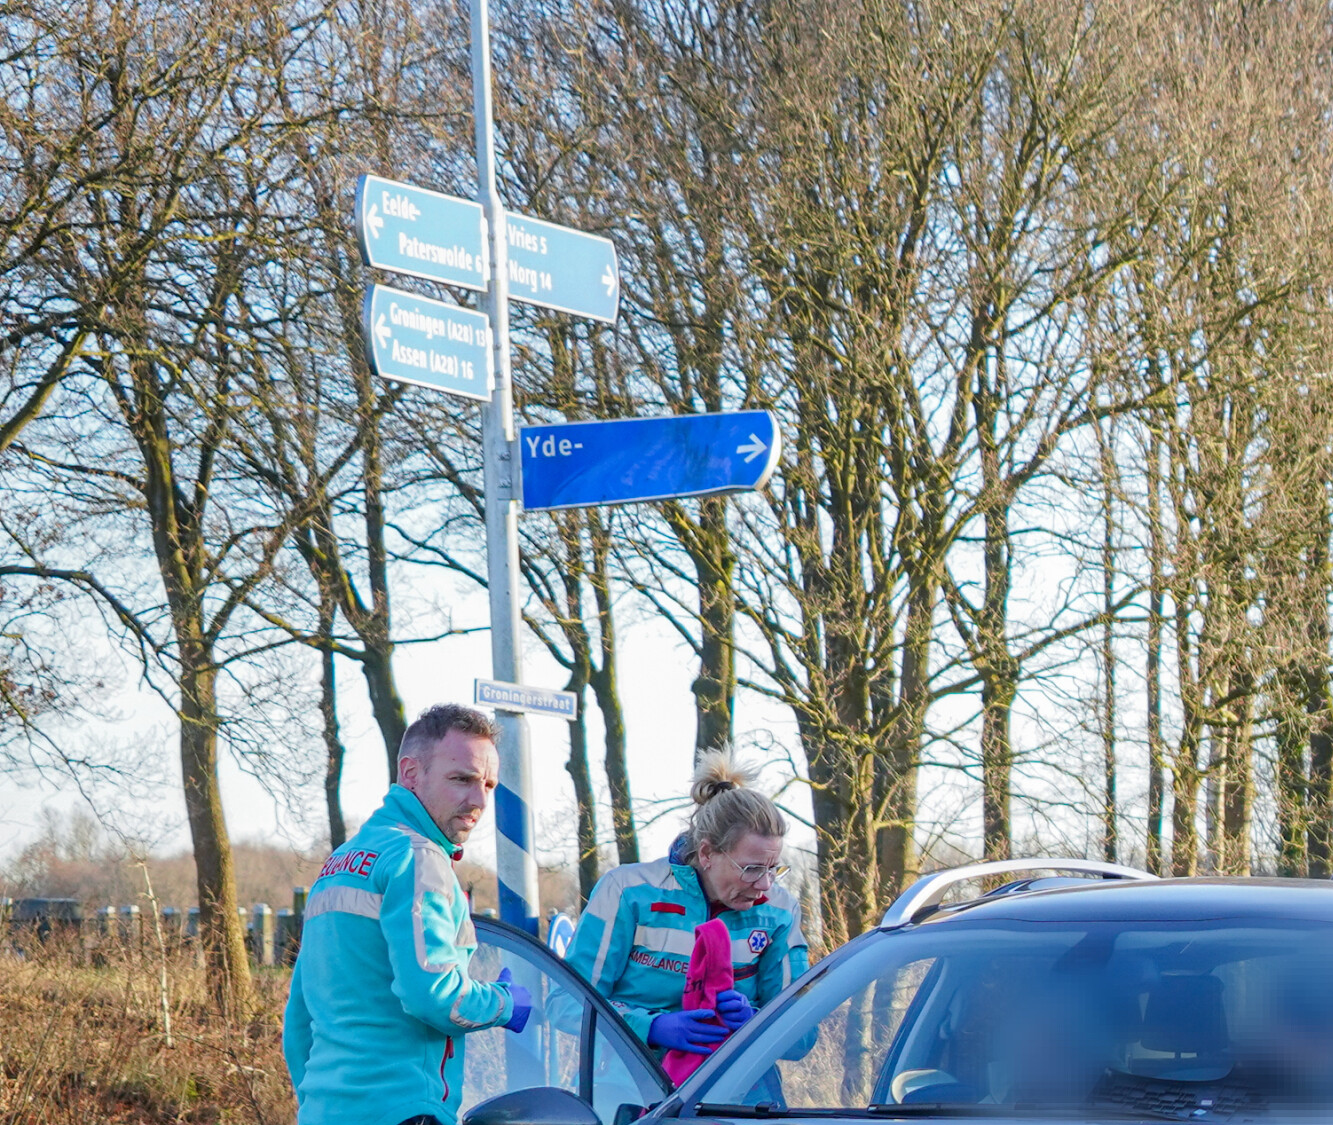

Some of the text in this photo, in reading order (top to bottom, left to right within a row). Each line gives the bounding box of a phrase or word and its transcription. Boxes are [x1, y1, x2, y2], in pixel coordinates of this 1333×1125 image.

[382, 191, 421, 221] Eelde-
[398, 231, 473, 271] Paterswolde
[507, 223, 548, 255] Vries 5
[508, 259, 552, 293] Norg 14
[390, 302, 486, 347] Groningen (A28) 13
[391, 338, 475, 380] Assen (A28) 16
[526, 434, 584, 458] Yde-
[483, 685, 570, 711] Groningerstraat
